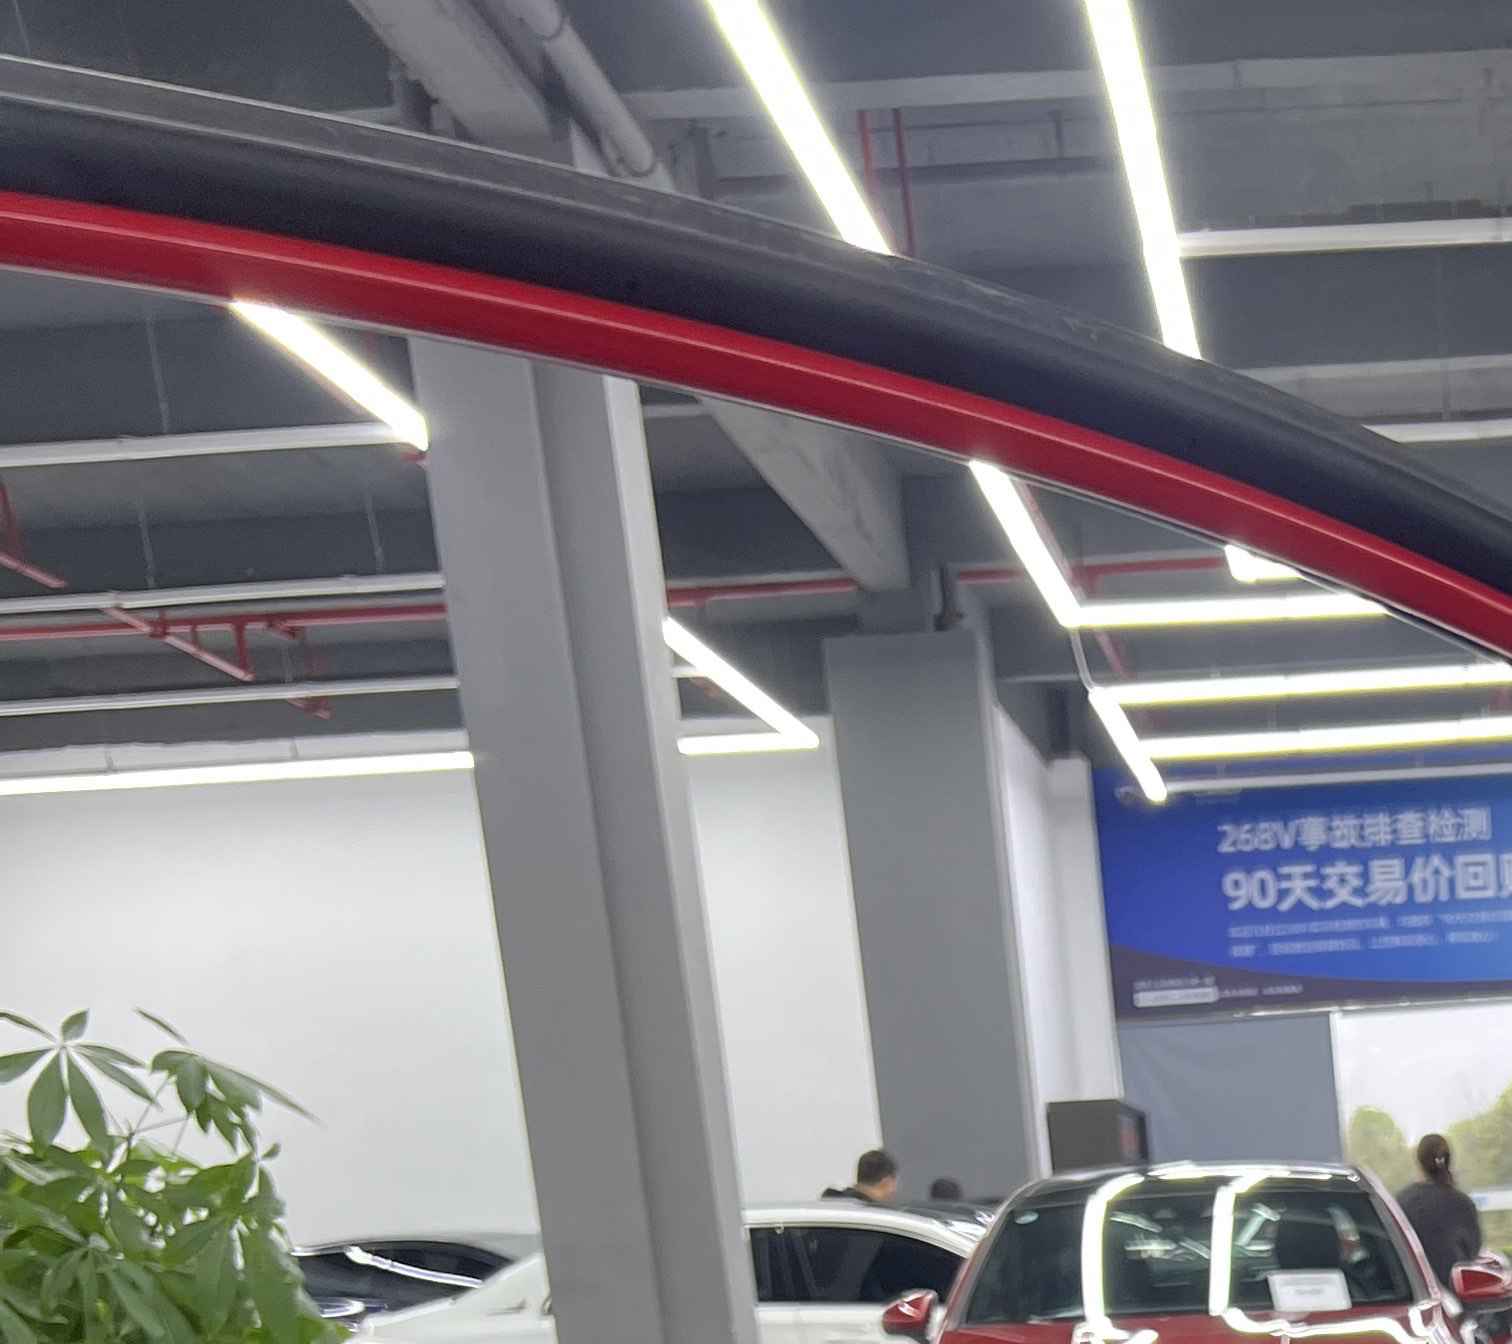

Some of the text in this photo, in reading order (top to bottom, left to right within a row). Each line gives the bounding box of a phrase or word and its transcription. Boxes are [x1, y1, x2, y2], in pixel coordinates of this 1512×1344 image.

[1217, 806, 1492, 853] 268V事故排查检测
